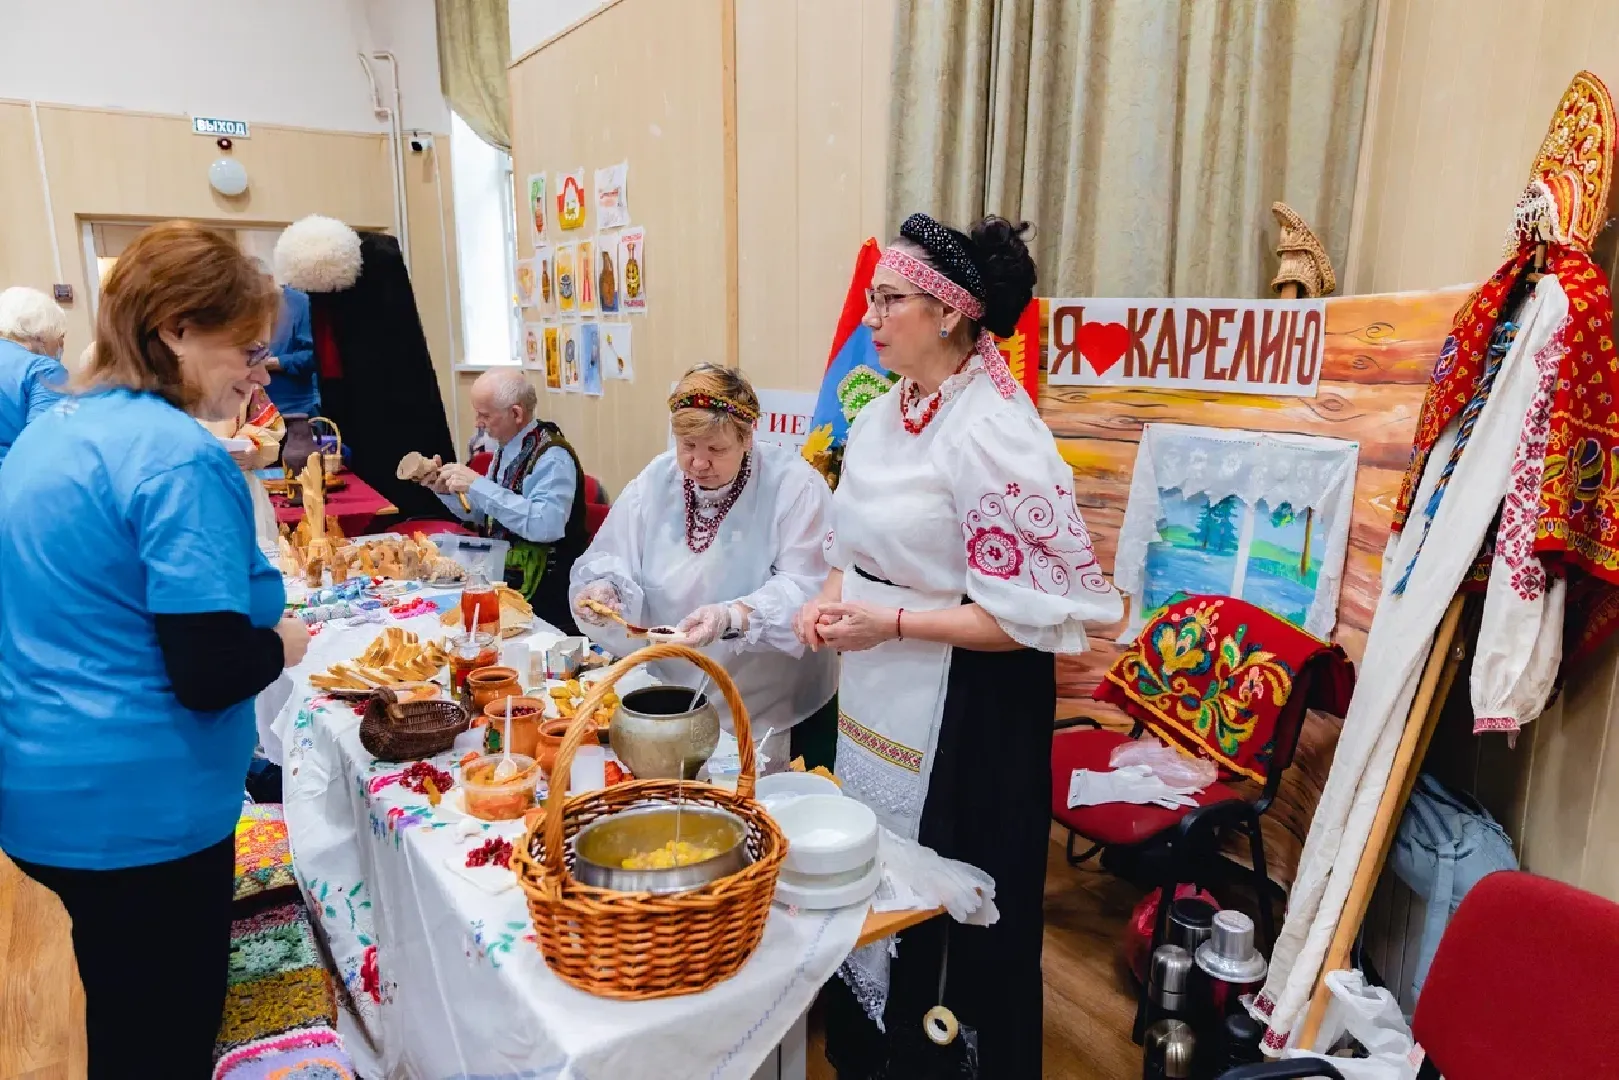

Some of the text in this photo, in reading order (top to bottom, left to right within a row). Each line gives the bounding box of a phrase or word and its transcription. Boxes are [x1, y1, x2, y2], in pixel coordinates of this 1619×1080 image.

[197, 119, 246, 135] ВЫХОД
[1049, 306, 1321, 385] Я КАРЕЛИЮ
